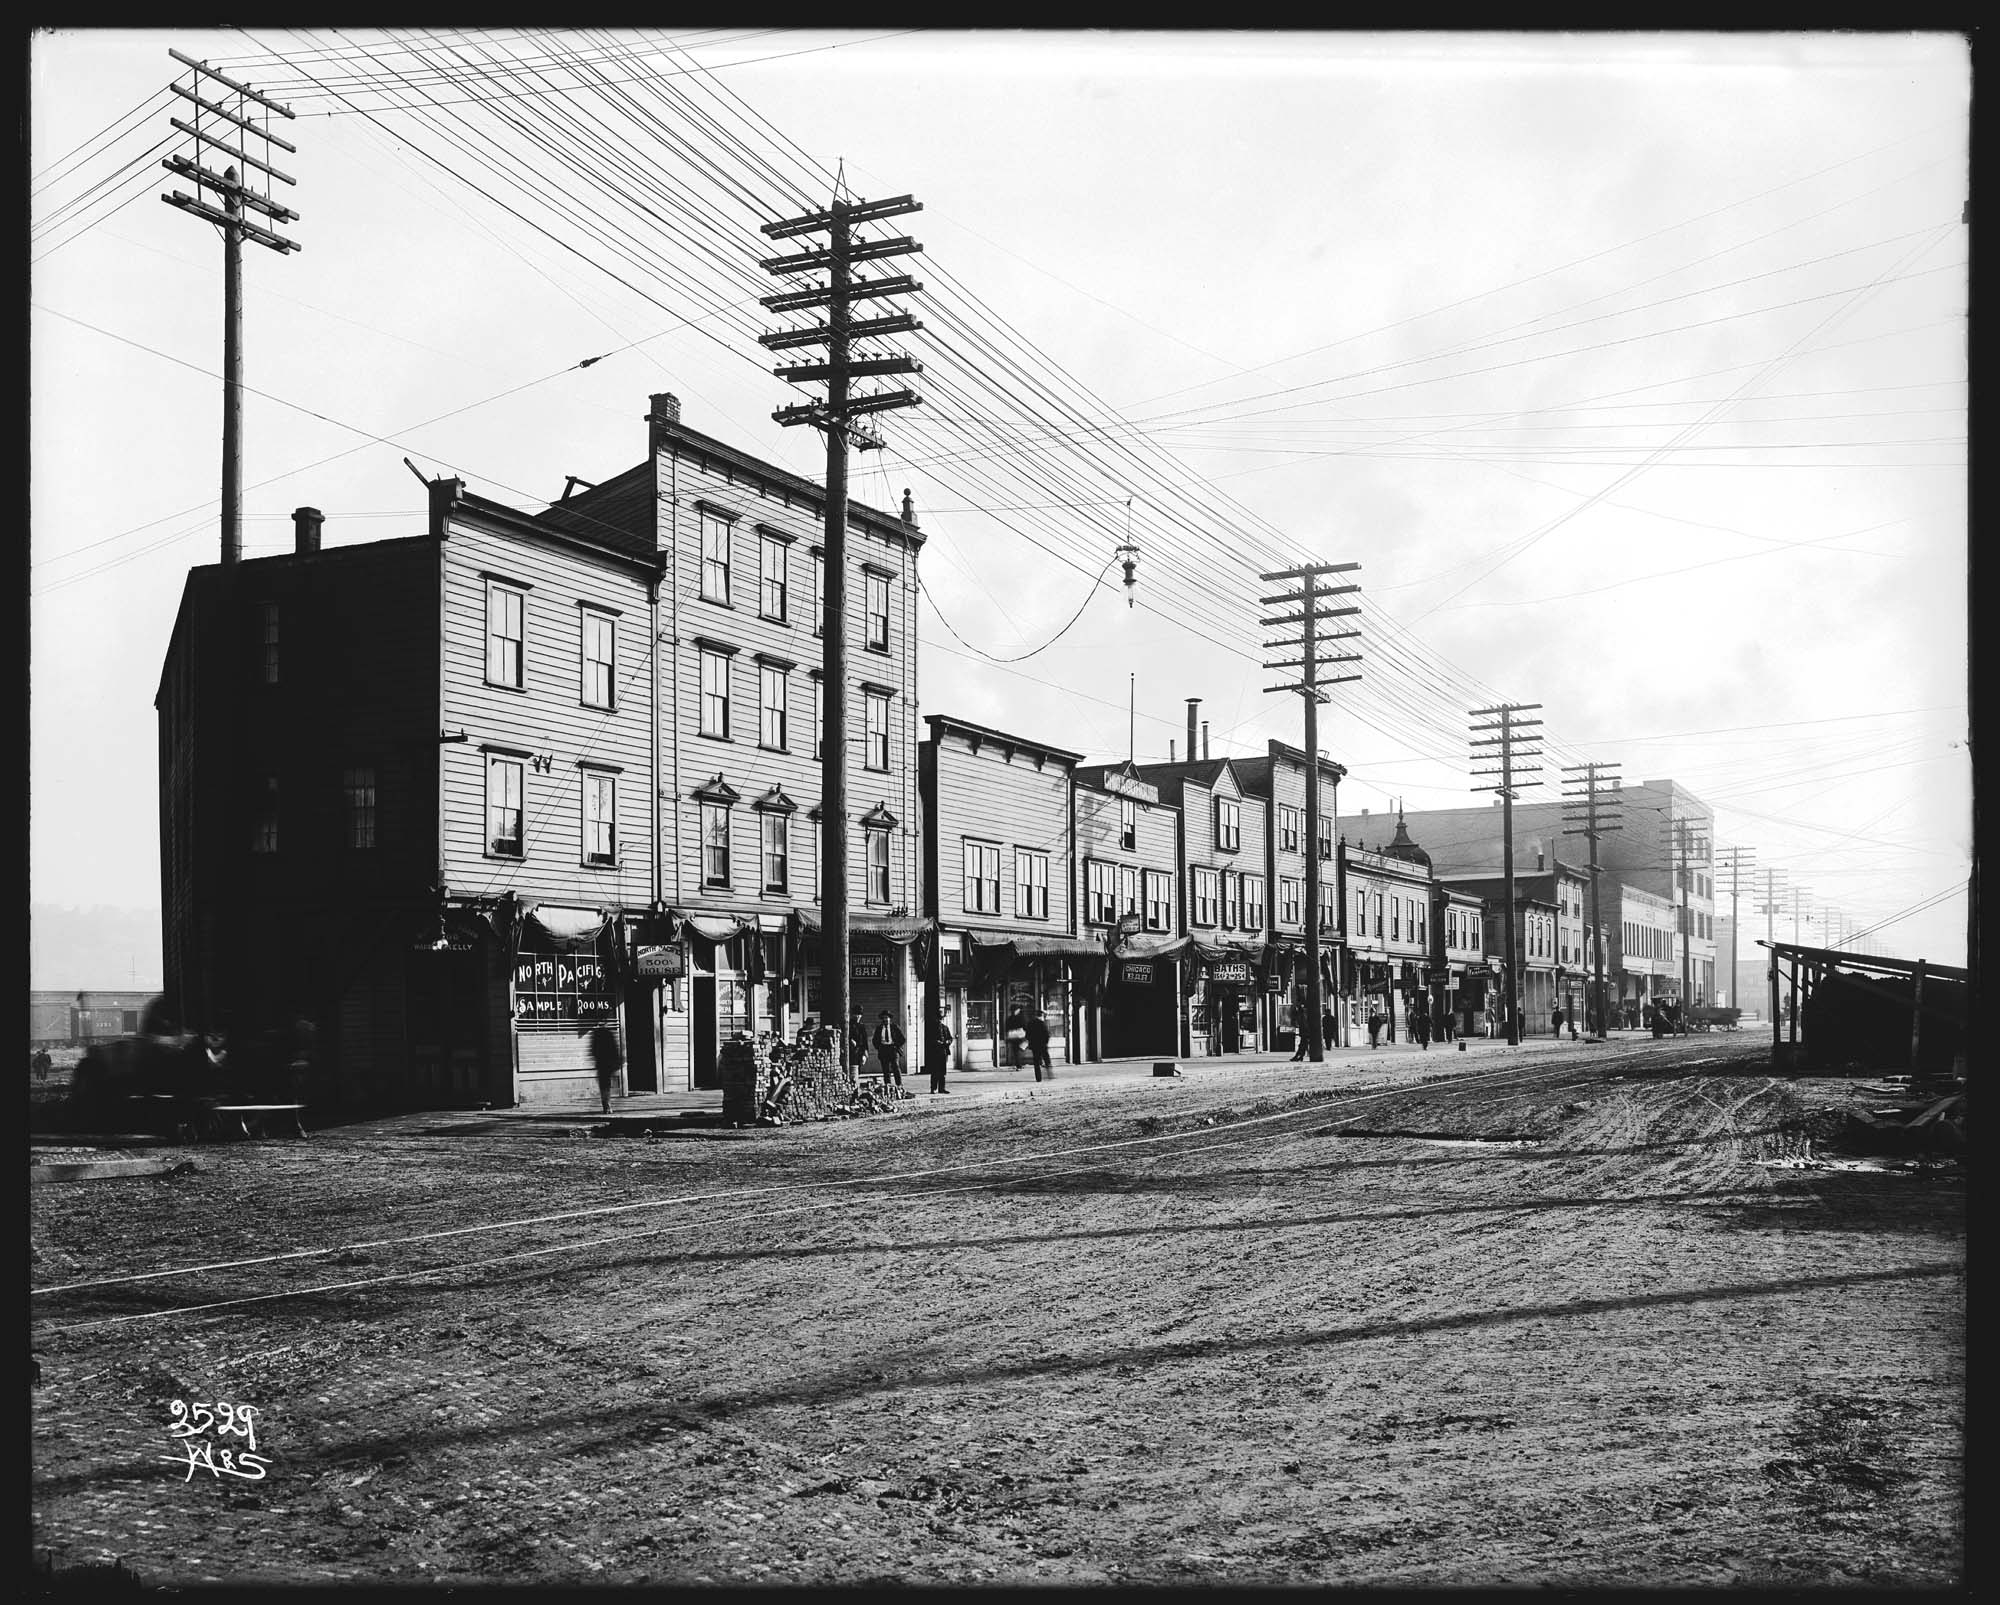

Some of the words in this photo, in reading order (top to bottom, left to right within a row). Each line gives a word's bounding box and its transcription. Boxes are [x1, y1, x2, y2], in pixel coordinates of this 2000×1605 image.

[639, 967, 681, 975] HOUSE
[855, 967, 878, 976] BAR
[1214, 964, 1245, 973] BATHS
[518, 962, 553, 983] NORTH
[558, 963, 602, 989] PACIFIC
[1127, 973, 1148, 981] BAR
[519, 998, 563, 1014] SAMPLE
